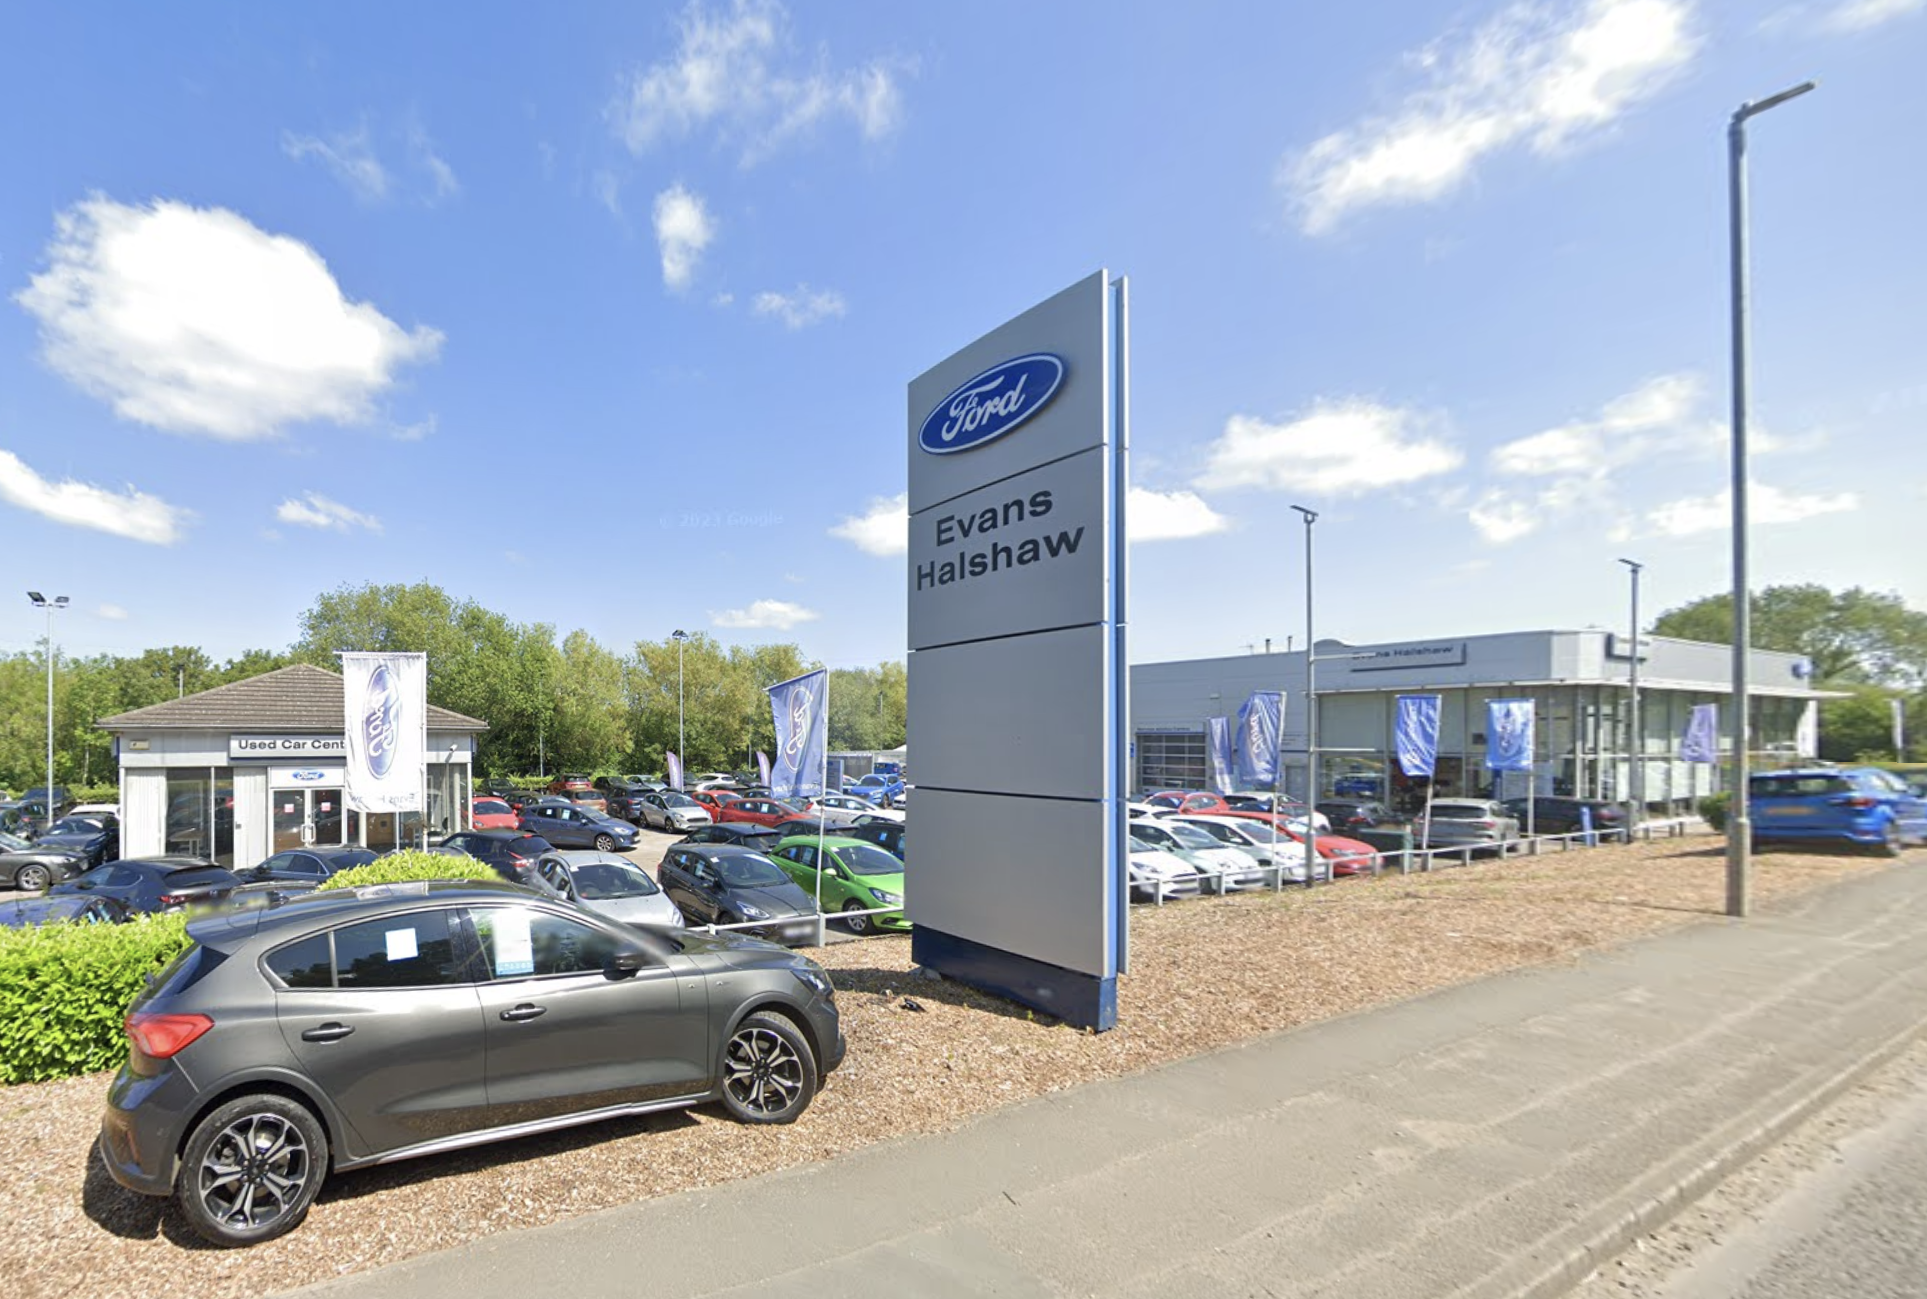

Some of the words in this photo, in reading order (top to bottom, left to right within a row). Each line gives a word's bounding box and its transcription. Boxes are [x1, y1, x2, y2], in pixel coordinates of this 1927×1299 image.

[941, 372, 1029, 442] Ford
[936, 490, 1053, 547] Evans
[916, 526, 1085, 591] Halshaw
[238, 739, 277, 750] Used
[281, 739, 307, 750] Car
[311, 739, 345, 750] Cent
